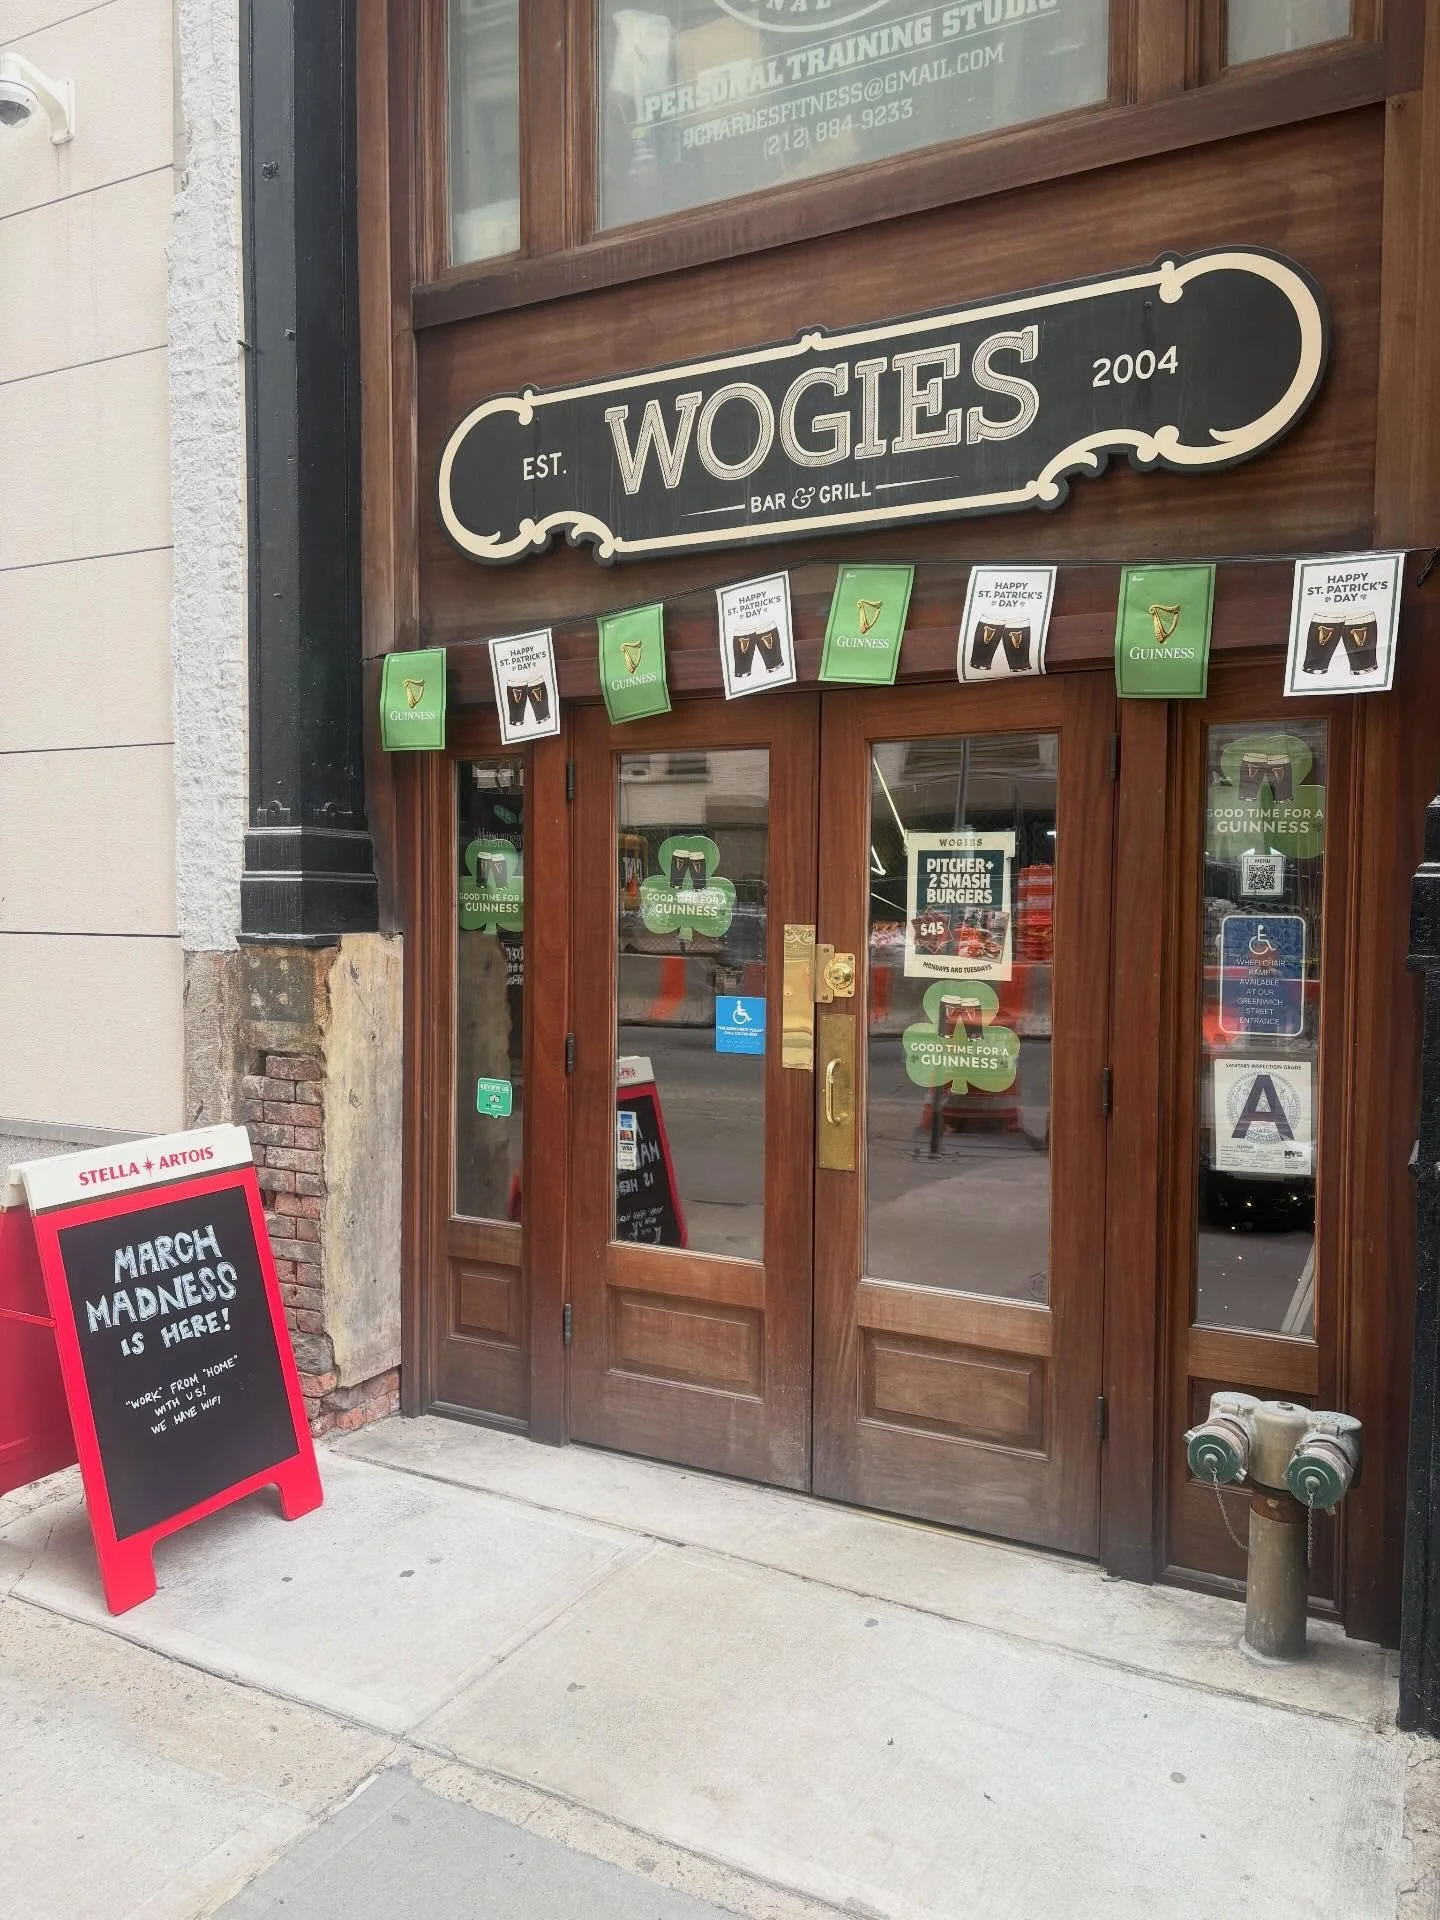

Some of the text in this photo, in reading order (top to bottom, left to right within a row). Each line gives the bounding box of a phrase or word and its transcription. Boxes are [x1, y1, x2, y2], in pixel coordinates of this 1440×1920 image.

[639, 62, 783, 123] PERSONAL
[787, 16, 932, 80] TRAINING
[764, 98, 913, 160] (212) 884-9233
[1091, 344, 1179, 389] 2004
[605, 325, 1041, 497] WOGIES
[521, 451, 568, 481] EST.
[750, 480, 872, 513] BAR & GRILL
[1327, 572, 1369, 584] HAPPY
[995, 582, 1029, 590] HAPPY
[1307, 580, 1388, 596] ST. PATRICK'S
[738, 591, 767, 605] HAPPY
[977, 591, 1043, 600] ST. PATRICK'S
[1333, 592, 1359, 603] DAY
[727, 595, 781, 616] ST. PATRICK'S
[998, 600, 1019, 608] DAY
[745, 609, 763, 620] DAY
[836, 635, 890, 649] GUINNESS
[510, 646, 534, 657] HAPPY
[1129, 646, 1195, 660] GUINNESS
[500, 651, 547, 668] ST. PATRICK'S
[517, 662, 531, 671] DAY
[611, 672, 657, 692] GUINNESS
[390, 710, 436, 722] GUINNESS
[1247, 808, 1280, 818] TIME
[1284, 809, 1311, 818] FOR
[1315, 809, 1324, 819] A
[1216, 821, 1310, 834] GUINNESS
[939, 838, 983, 846] WOGIES
[926, 858, 994, 873] PITCHER+
[929, 874, 991, 888] 2 SMASH
[460, 893, 520, 902] GOOD TIME FOR
[646, 892, 673, 902] GOOD
[926, 888, 993, 904] BURGERS
[465, 902, 519, 913] GUINNESS
[655, 903, 718, 917] GUINNESS
[920, 922, 944, 936] $45
[922, 962, 950, 972] MONDAYS
[964, 964, 992, 974] TUESDAYS
[1239, 978, 1280, 986] AVAILABLE
[1246, 988, 1275, 996] AT OUR
[1237, 998, 1283, 1006] GREENWICH
[1239, 1017, 1280, 1025] ENTRANCE
[910, 1042, 1010, 1057] GOOD TIME FOR A
[921, 1054, 998, 1070] GUINNESS
[1232, 1074, 1295, 1141] A
[78, 1146, 214, 1186] STELLA ARTOIS
[114, 1224, 223, 1284] MARCH
[86, 1261, 238, 1333] MADNESS
[120, 1307, 231, 1357] IS HERE!
[170, 1373, 199, 1392] FROM
[154, 1384, 207, 1416] WITH US!
[151, 1396, 221, 1435] WE HAVE WIFI
